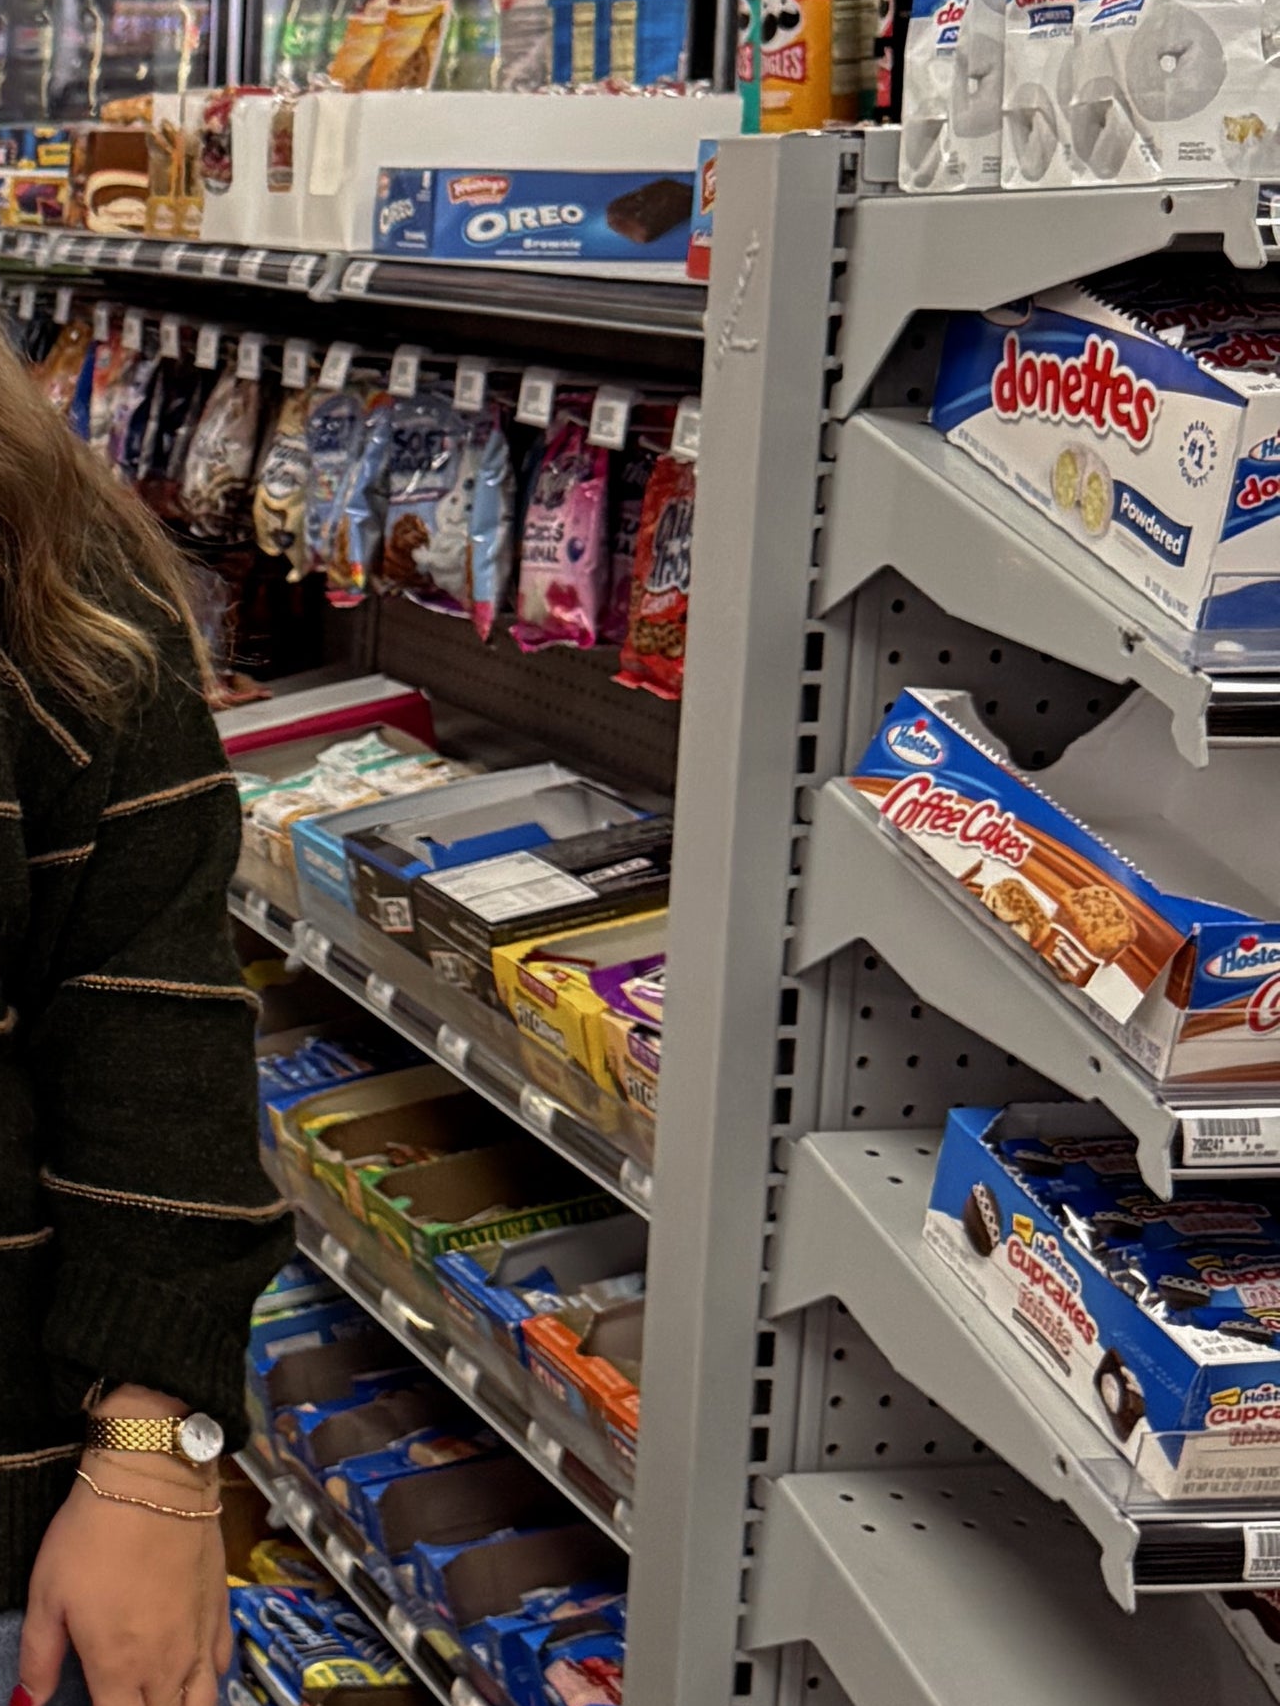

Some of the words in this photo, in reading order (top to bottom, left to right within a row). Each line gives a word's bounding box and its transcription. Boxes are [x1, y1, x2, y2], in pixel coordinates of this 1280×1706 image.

[466, 203, 584, 242] OREO
[993, 332, 1158, 445] donettes
[1119, 491, 1185, 557] Powdered
[880, 776, 968, 834] Coffee
[959, 803, 1030, 864] Cakes
[1007, 1239, 1096, 1346] Cupcakes
[1208, 1405, 1280, 1426] Cupca
[1243, 1390, 1280, 1404] Host
